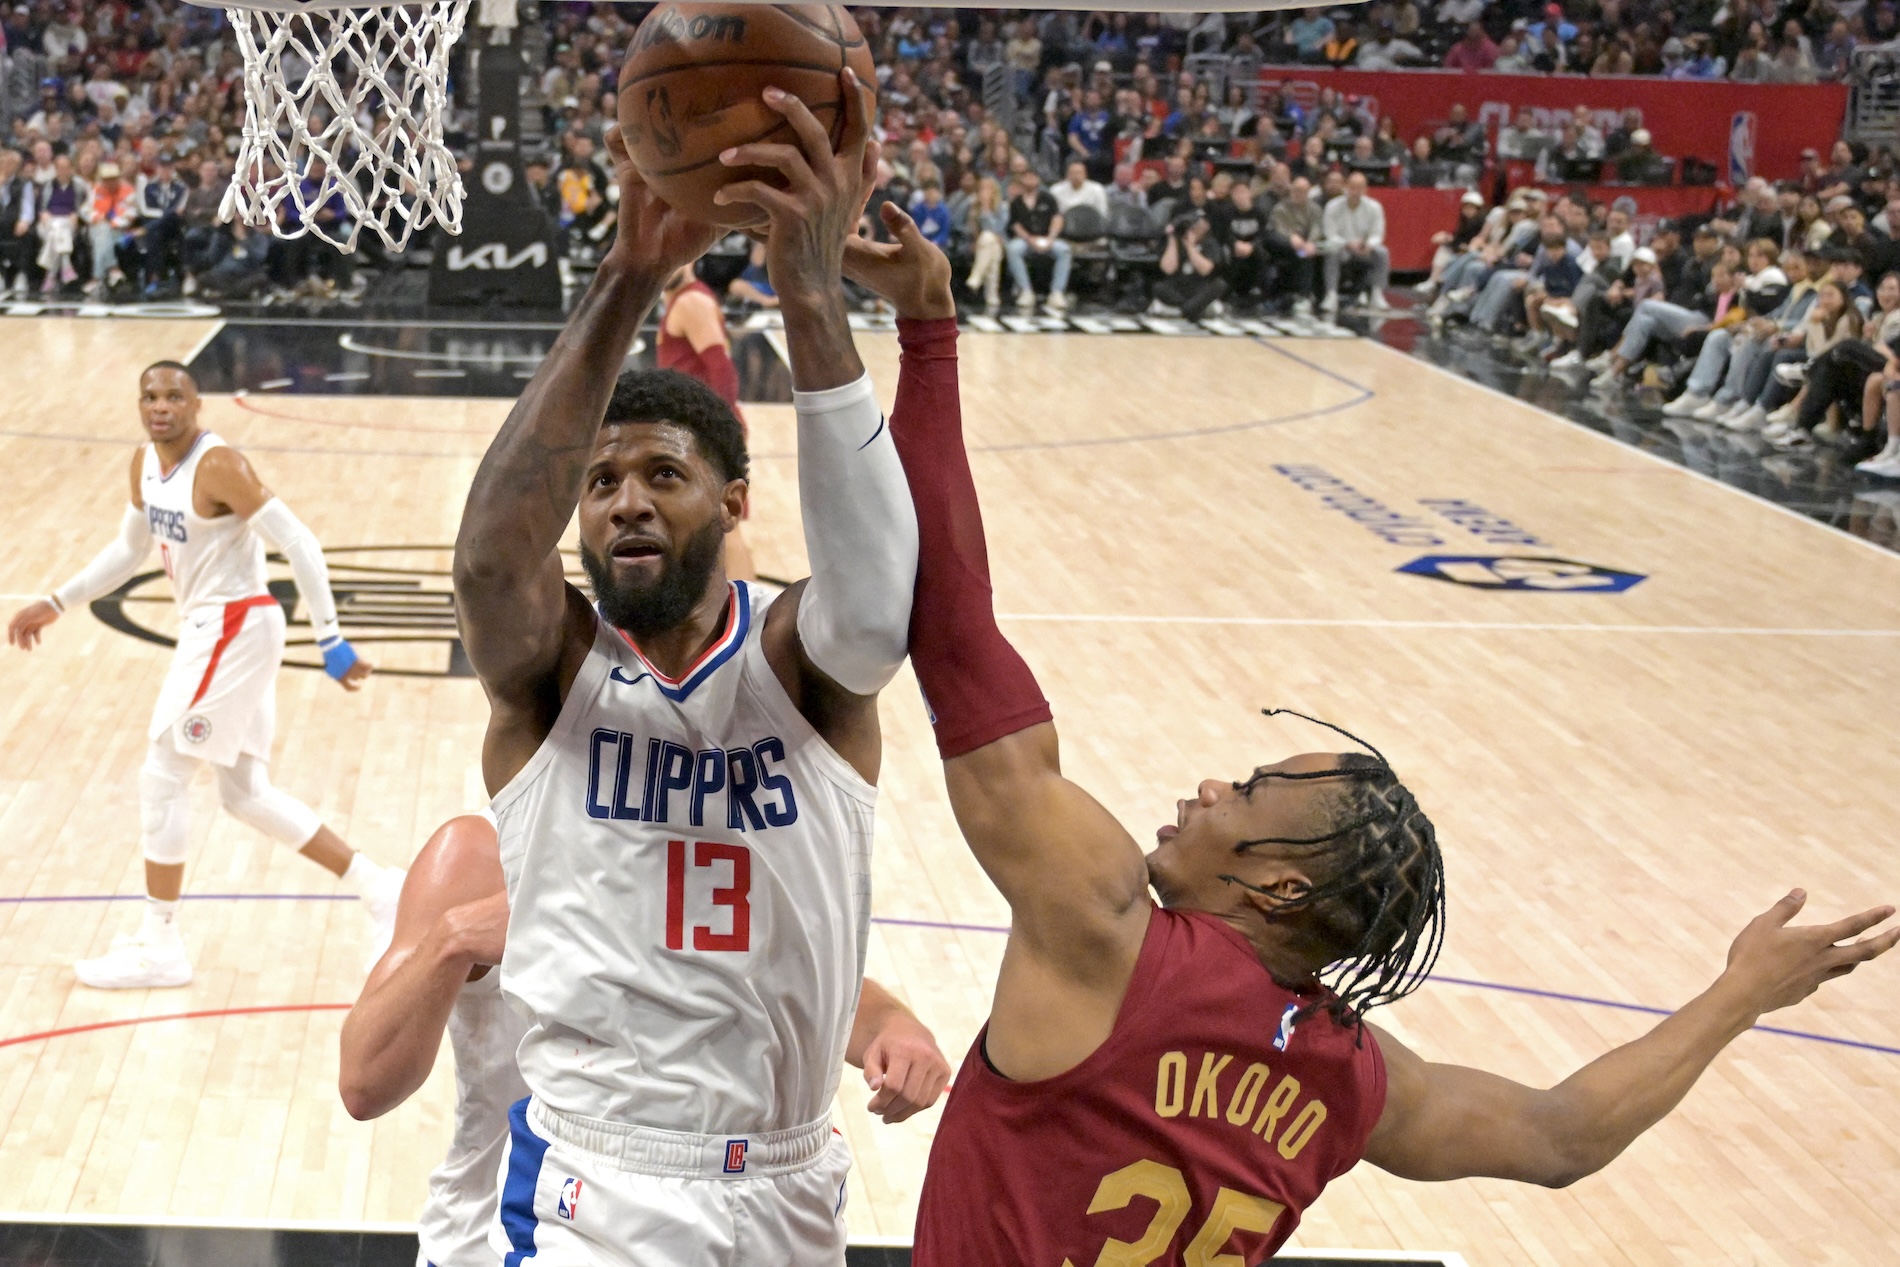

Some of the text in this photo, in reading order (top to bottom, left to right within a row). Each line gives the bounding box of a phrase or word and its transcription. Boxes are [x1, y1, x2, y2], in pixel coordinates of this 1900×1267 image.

[585, 727, 799, 833] CLIPPRS
[665, 840, 751, 952] 13
[1154, 1050, 1328, 1161] OKORO
